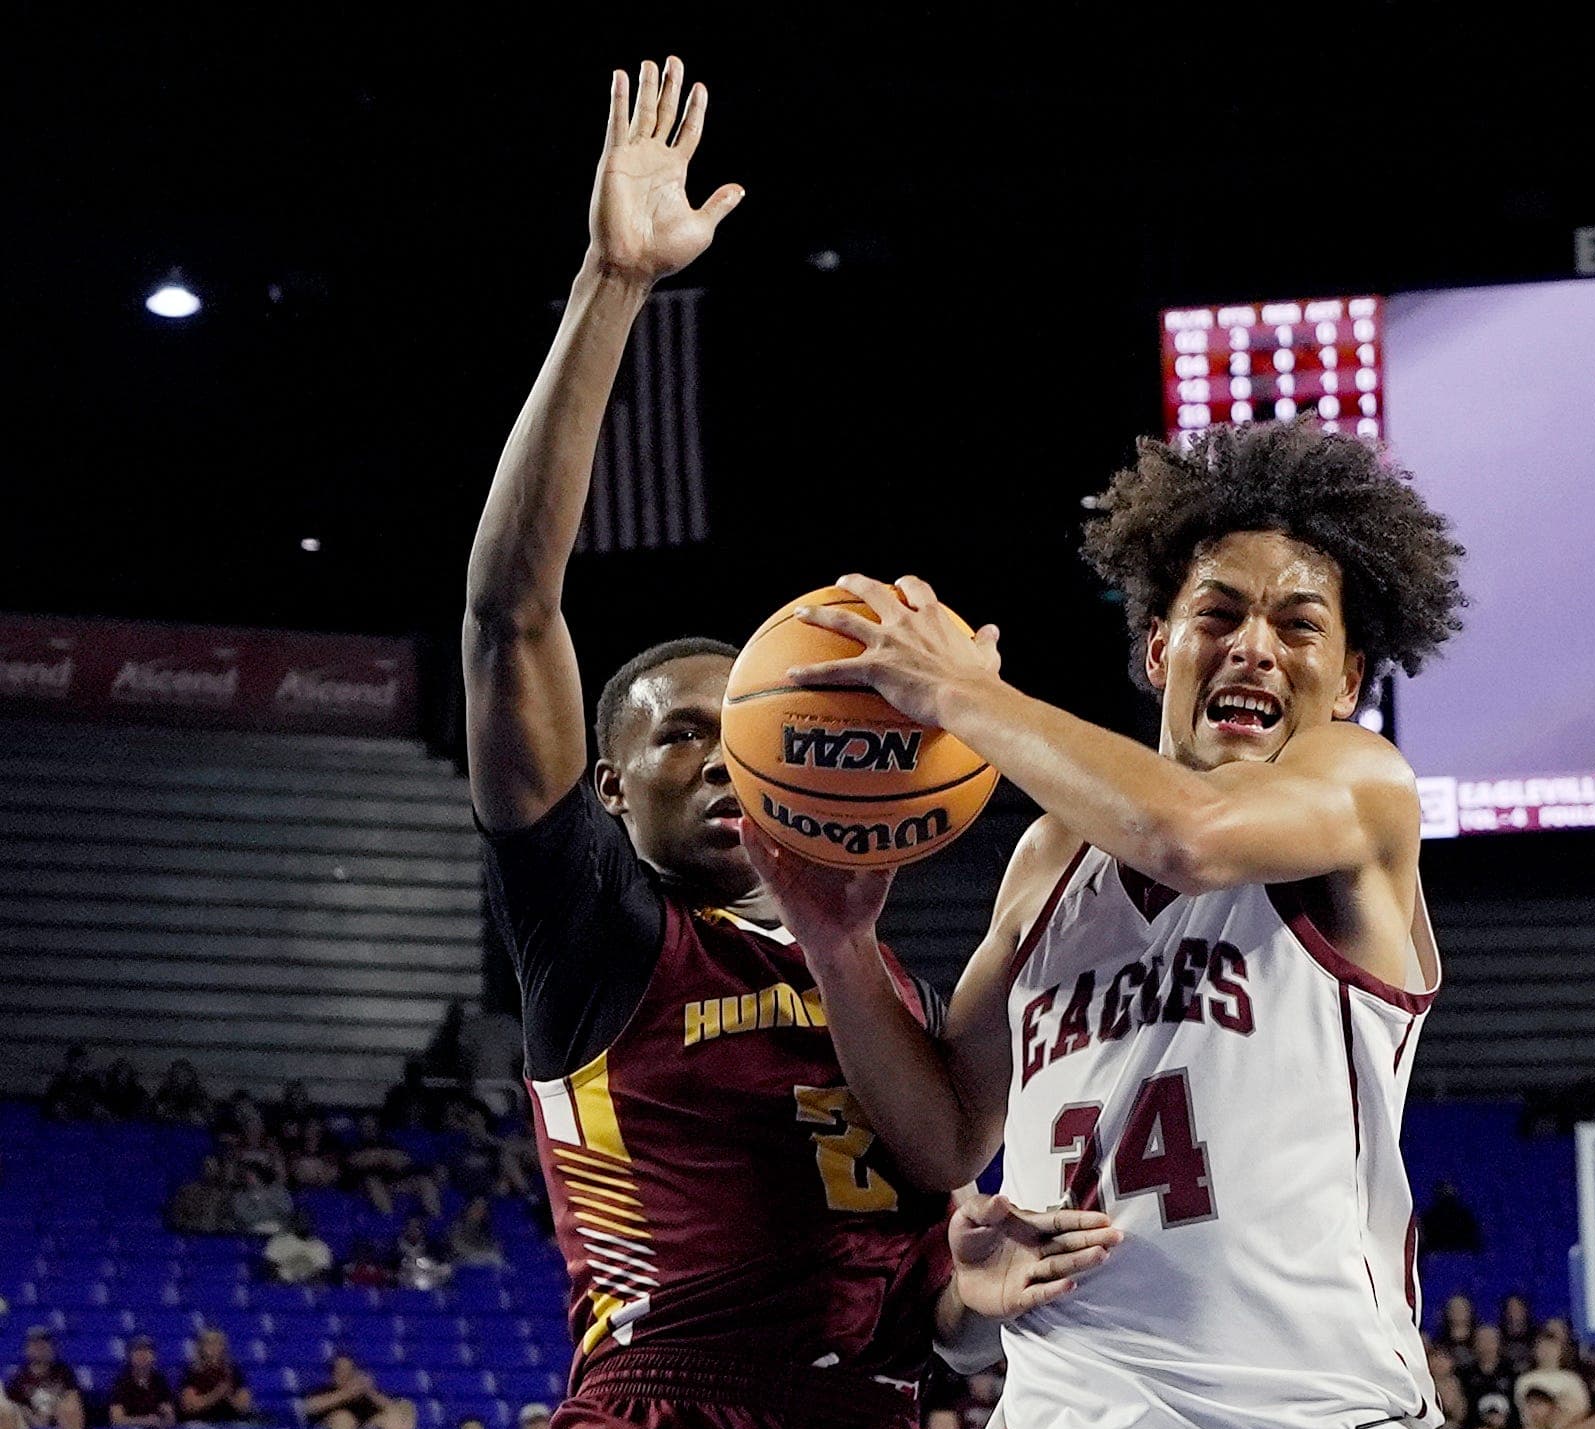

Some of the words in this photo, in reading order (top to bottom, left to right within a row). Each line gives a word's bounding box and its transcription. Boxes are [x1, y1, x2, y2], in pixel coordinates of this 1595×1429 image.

[783, 722, 923, 773] NCAA
[762, 789, 957, 855] Wilson
[1021, 937, 1257, 1092] EAGLES
